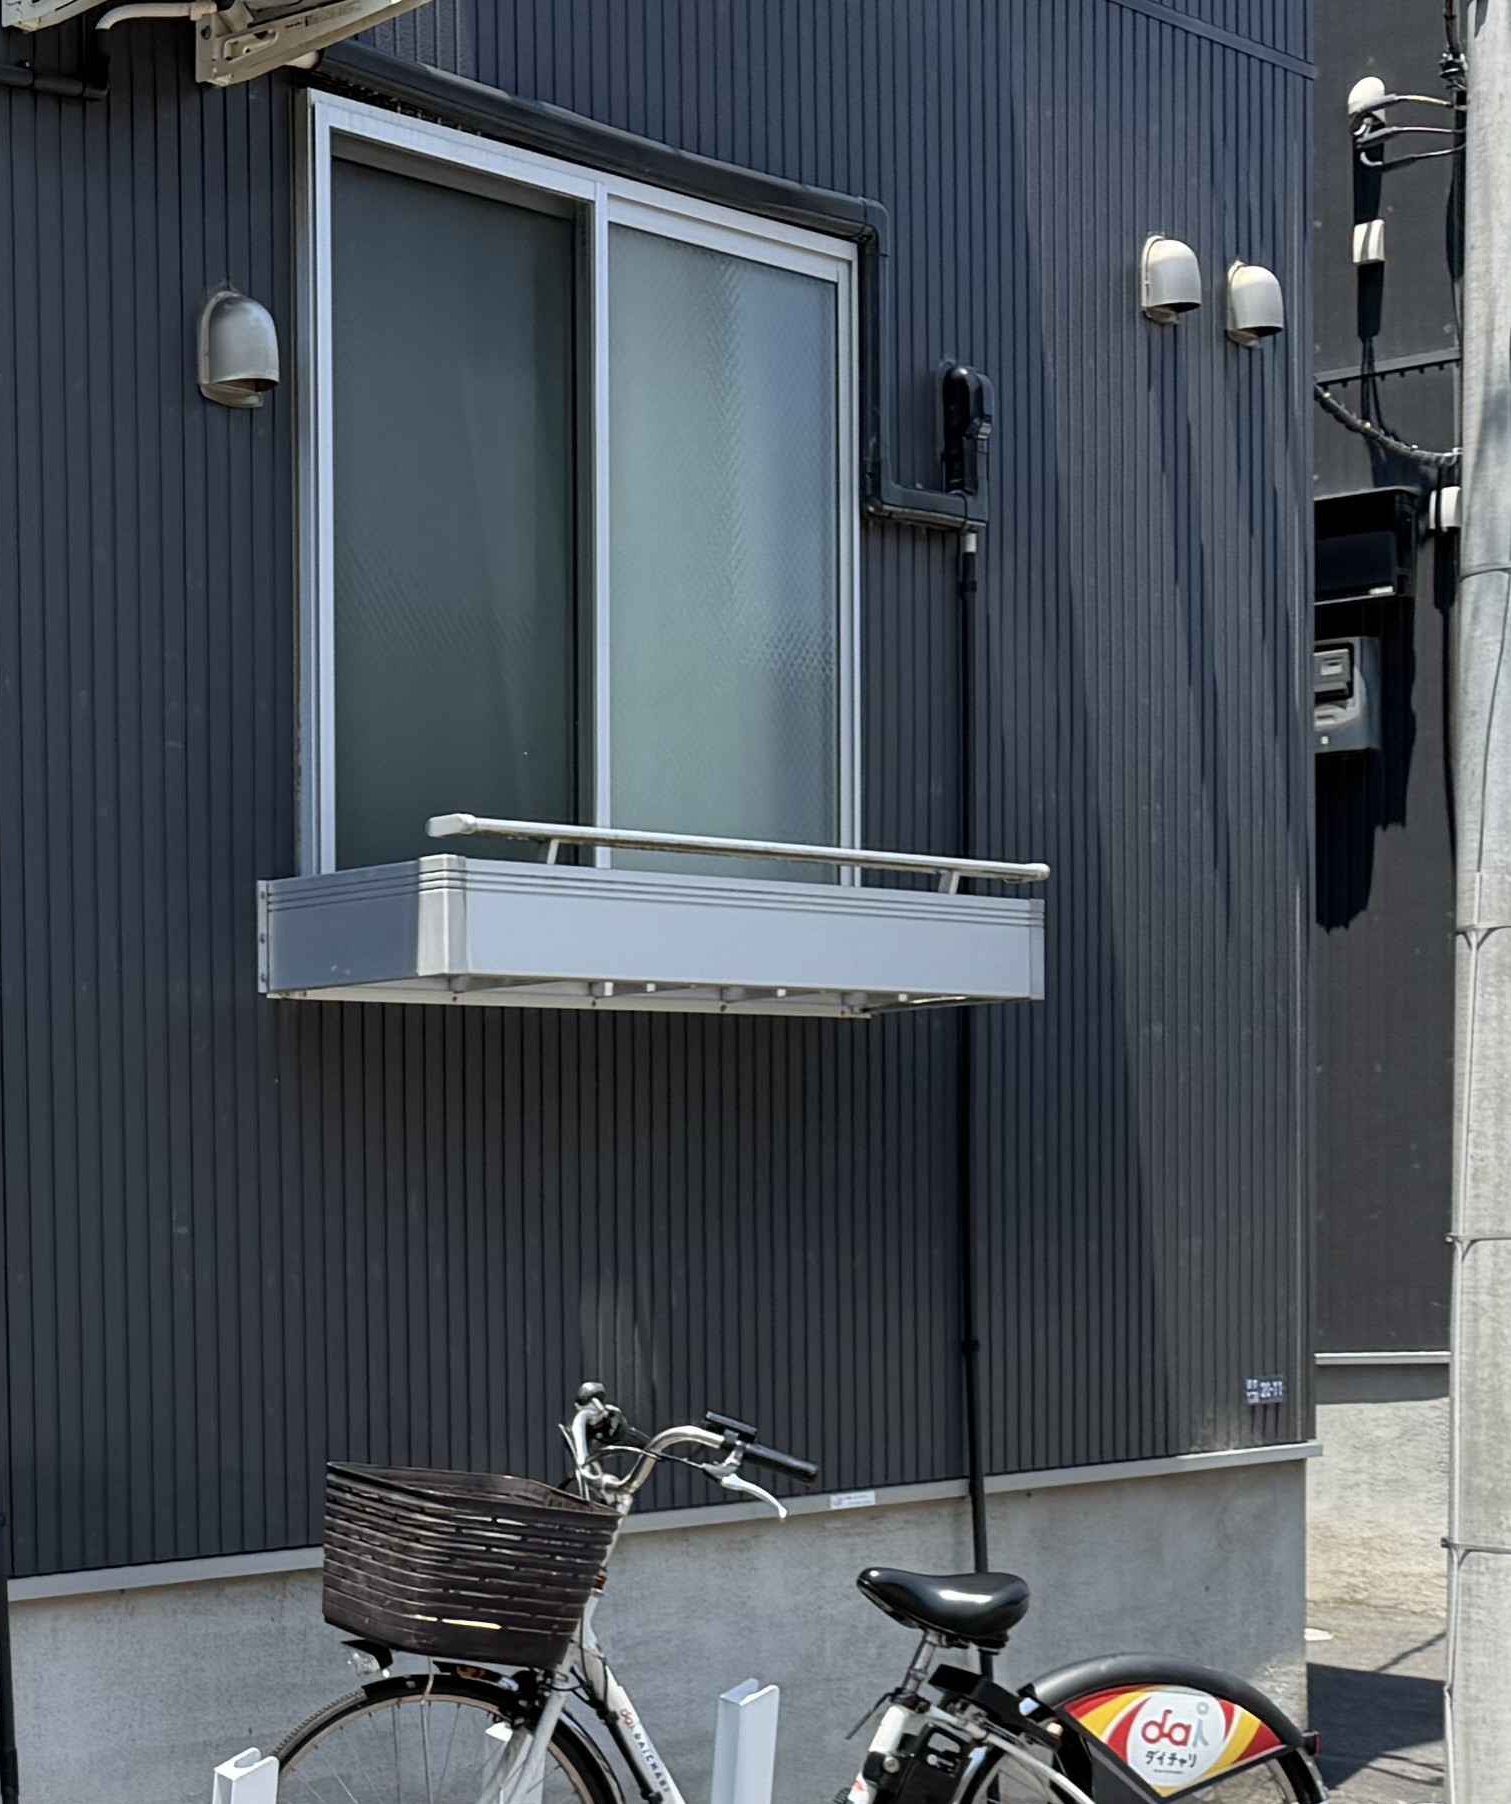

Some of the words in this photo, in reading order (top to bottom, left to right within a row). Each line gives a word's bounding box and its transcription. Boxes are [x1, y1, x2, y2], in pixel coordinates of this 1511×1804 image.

[1142, 1701, 1209, 1748] dai
[1145, 1750, 1197, 1768] ダイチャリ
